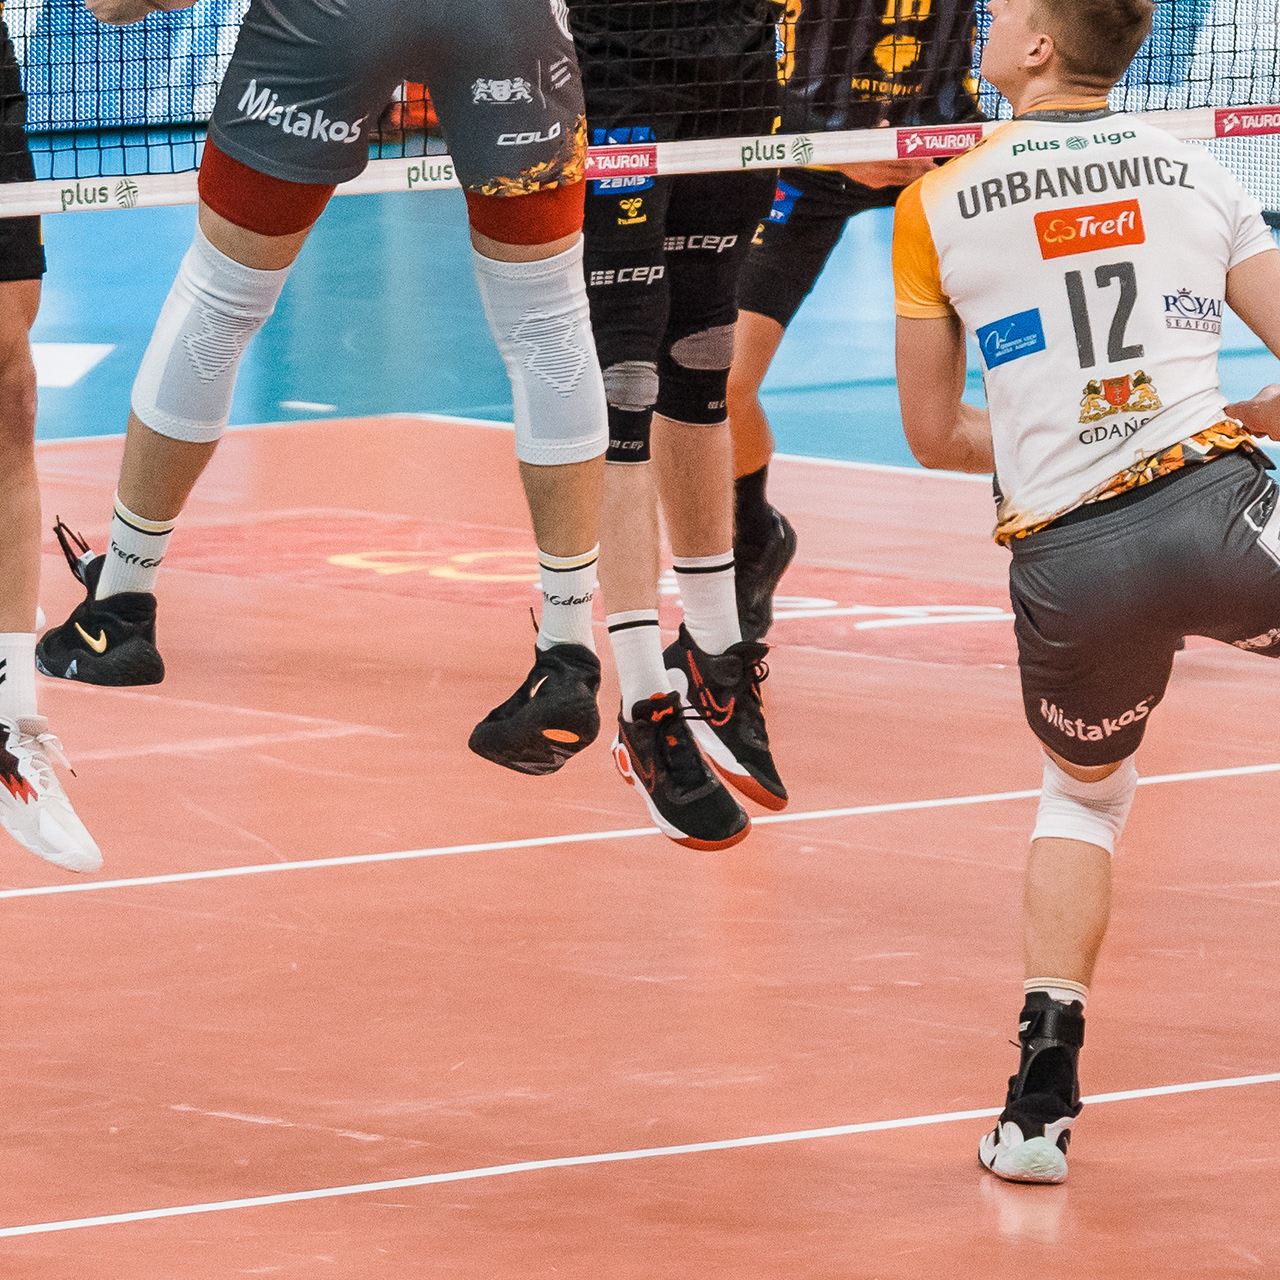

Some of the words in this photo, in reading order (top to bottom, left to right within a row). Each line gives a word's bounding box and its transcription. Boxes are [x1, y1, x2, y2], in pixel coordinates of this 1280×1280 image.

[237, 79, 363, 144] Mistakos
[496, 122, 561, 146] COLO
[923, 133, 977, 151] TAURON
[1012, 137, 1060, 156] plus
[1093, 130, 1137, 146] liga
[595, 154, 650, 170] TAURON
[741, 139, 786, 168] plus
[407, 160, 454, 187] plus
[61, 183, 108, 210] plus
[956, 155, 1195, 220] URBANOWICZ
[1076, 210, 1135, 238] Trefl
[687, 234, 739, 253] cep
[617, 265, 665, 285] cep
[1065, 261, 1145, 369] 12
[1079, 416, 1153, 446] GDAŃS
[550, 592, 594, 607] Gdańs
[1040, 697, 1150, 741] Mistakos
